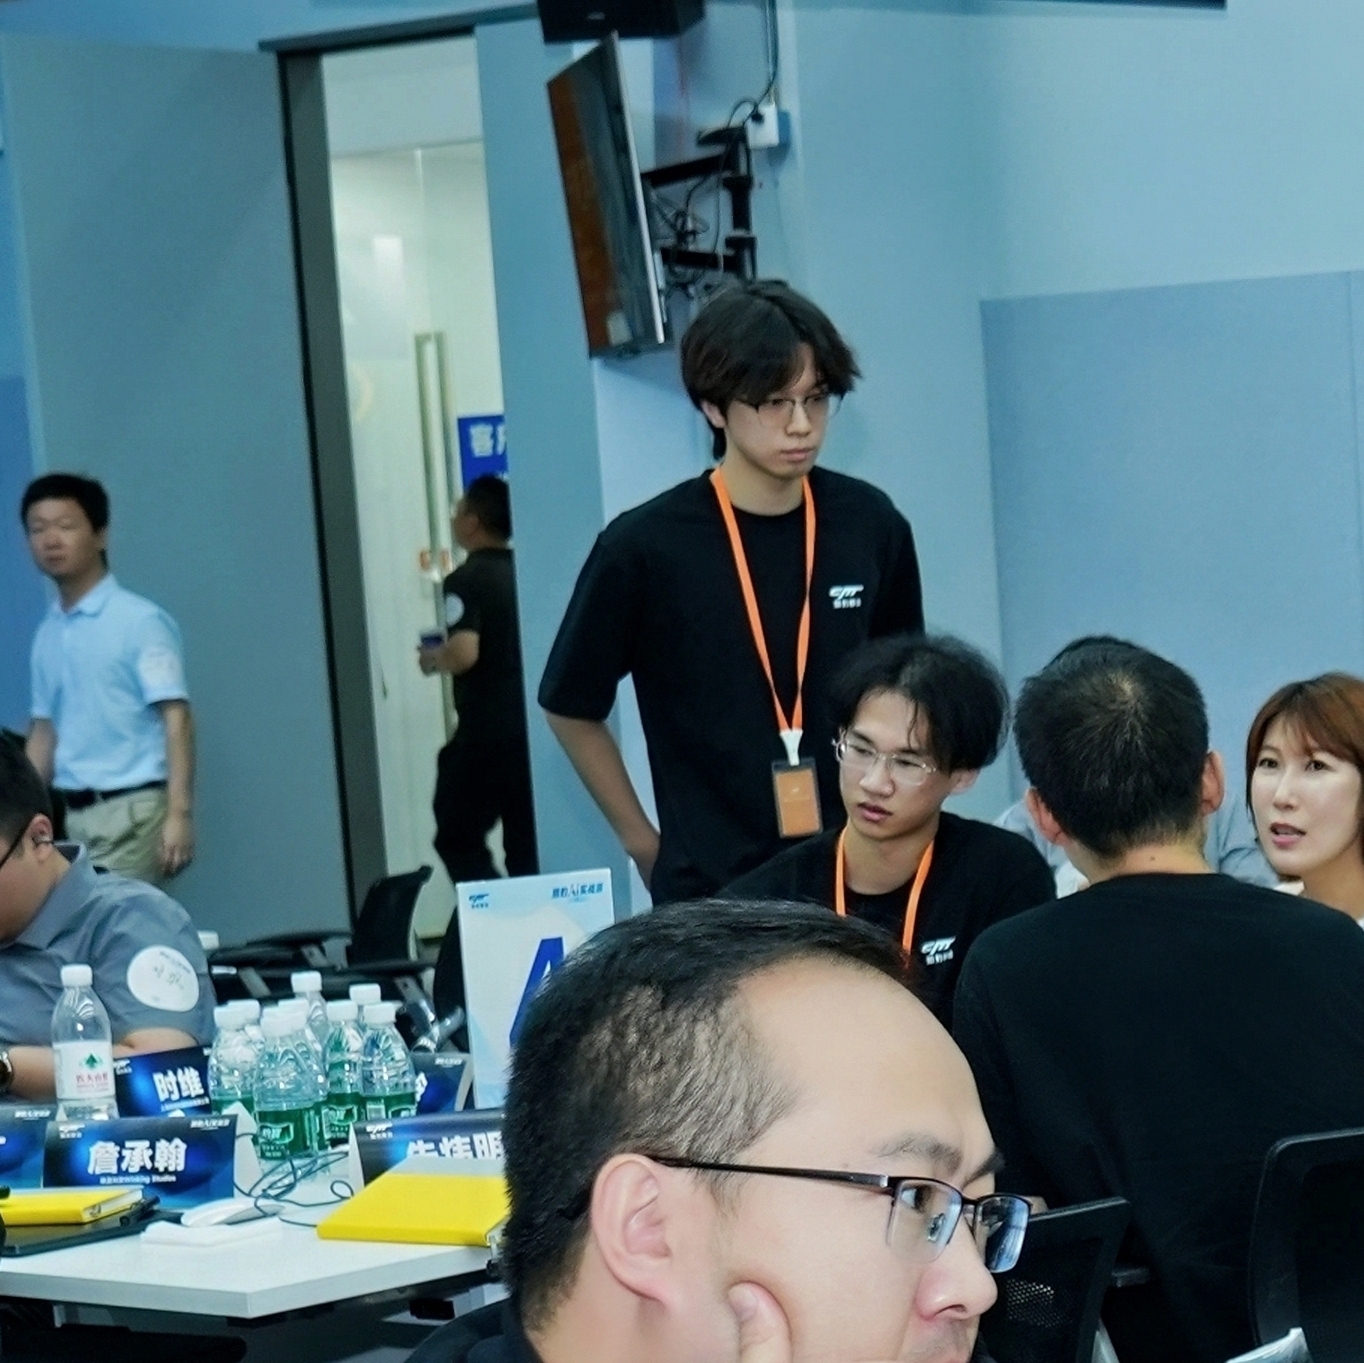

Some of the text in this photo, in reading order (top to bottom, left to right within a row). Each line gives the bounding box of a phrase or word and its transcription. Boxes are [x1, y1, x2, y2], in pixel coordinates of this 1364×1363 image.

[153, 1066, 205, 1102] 时维
[87, 1137, 187, 1175] 詹承翰
